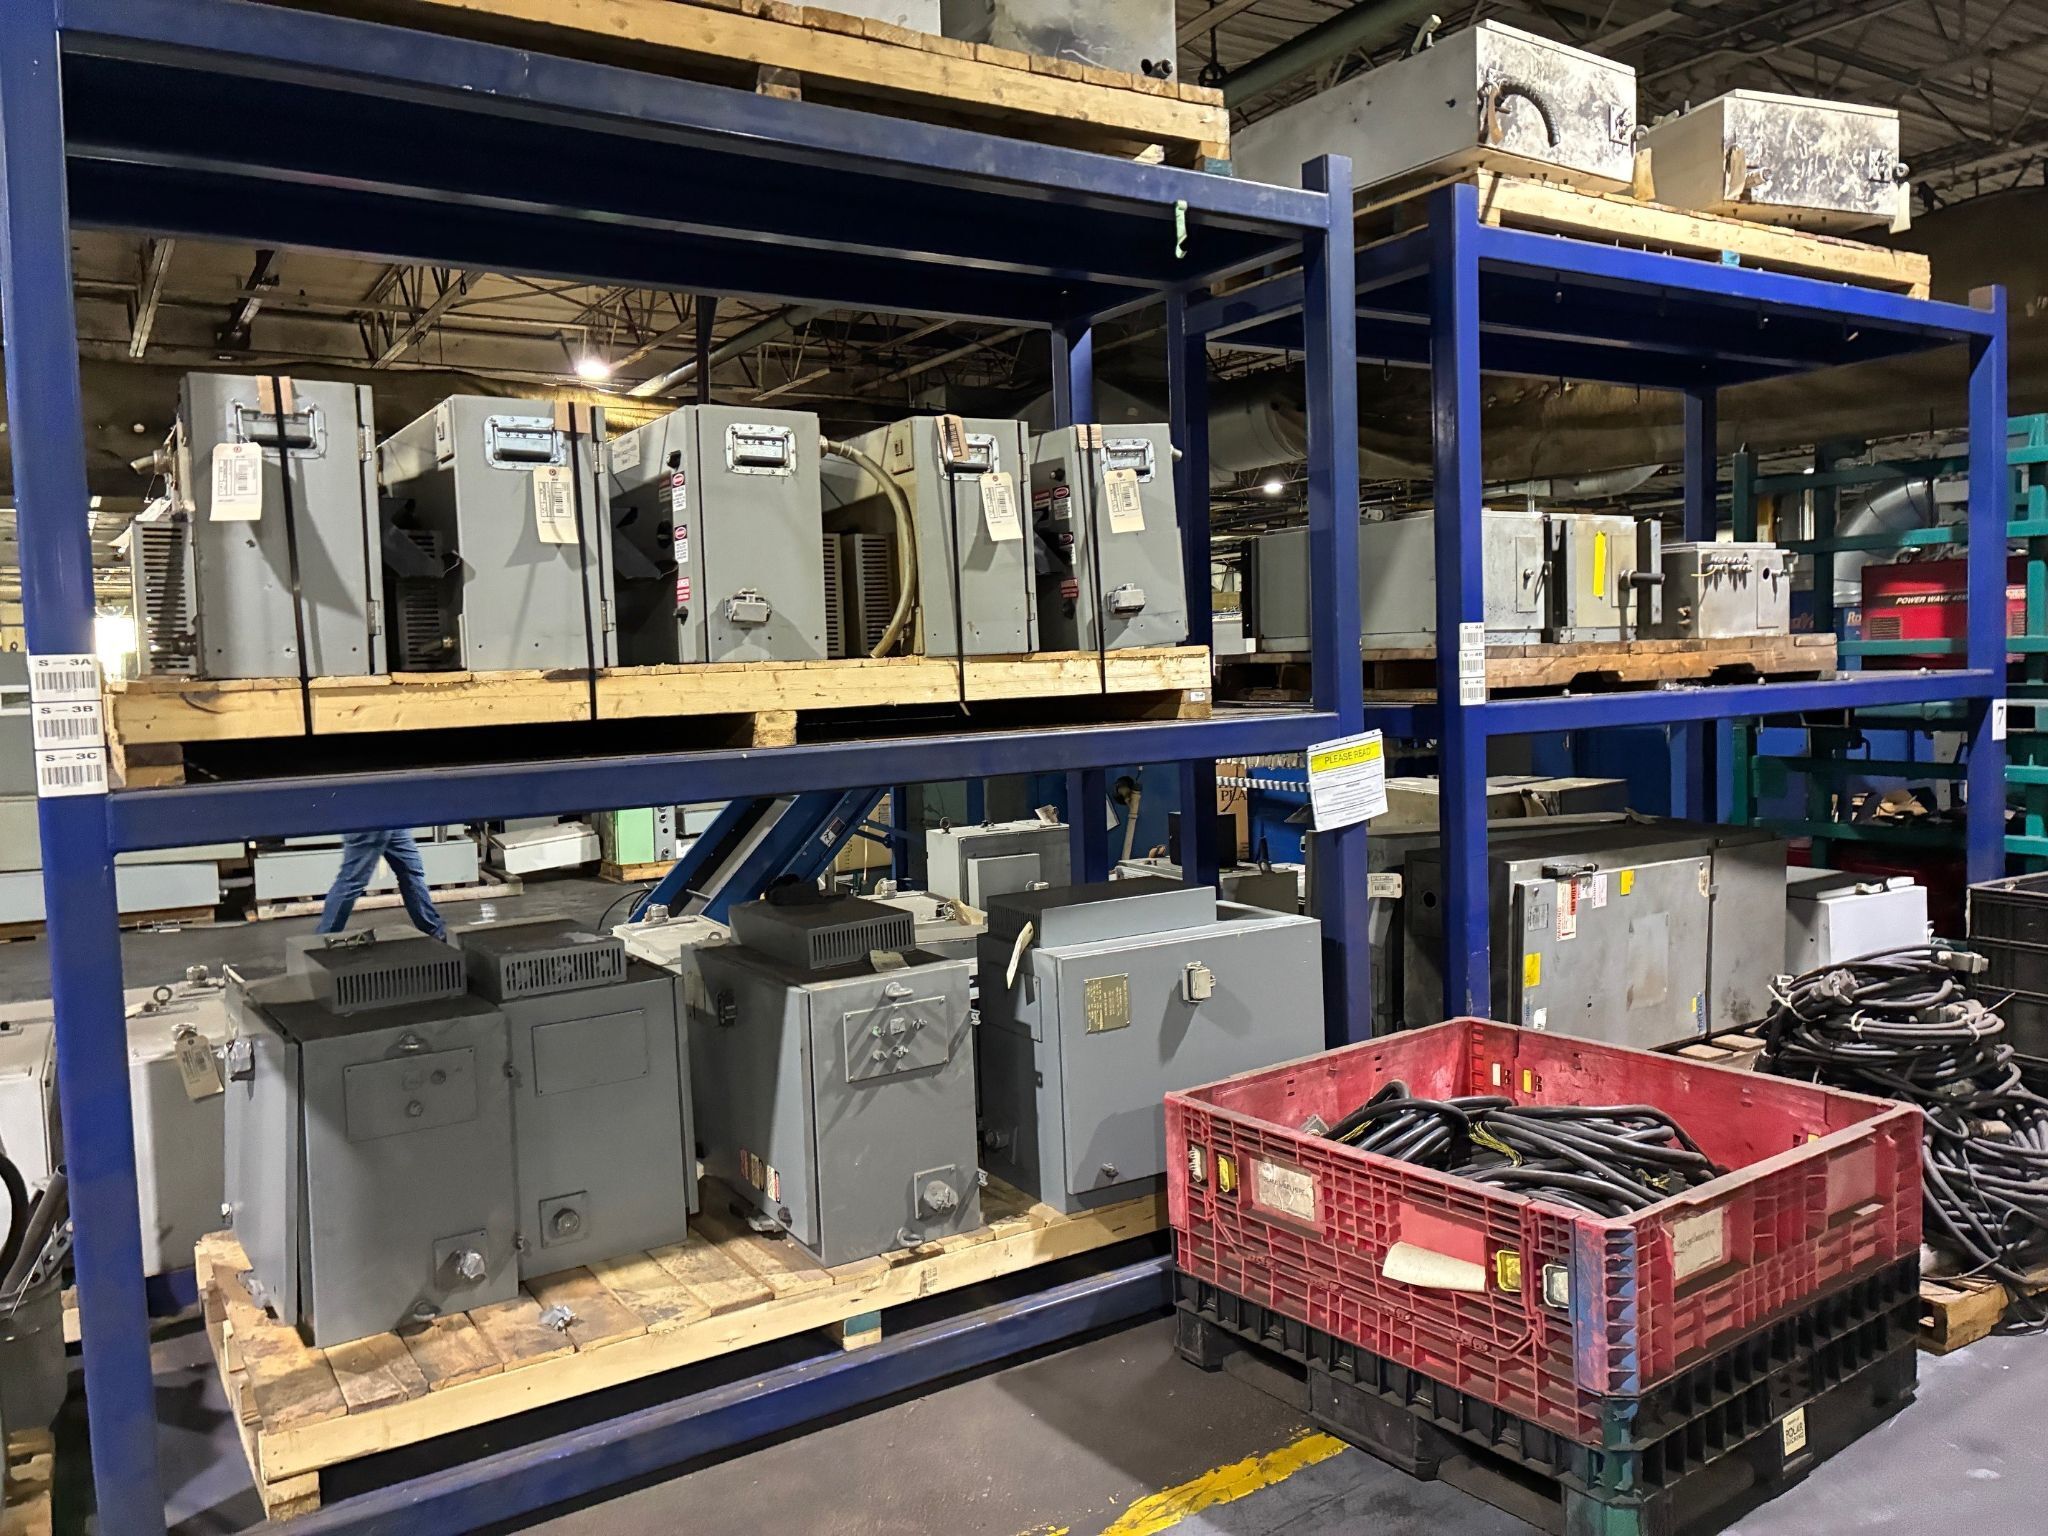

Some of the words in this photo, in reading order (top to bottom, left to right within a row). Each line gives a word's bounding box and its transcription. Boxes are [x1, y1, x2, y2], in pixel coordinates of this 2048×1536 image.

[1895, 596, 1926, 605] POWER
[1927, 594, 1951, 603] WAVE
[1324, 752, 1353, 765] PLEASE
[1353, 747, 1372, 759] READ
